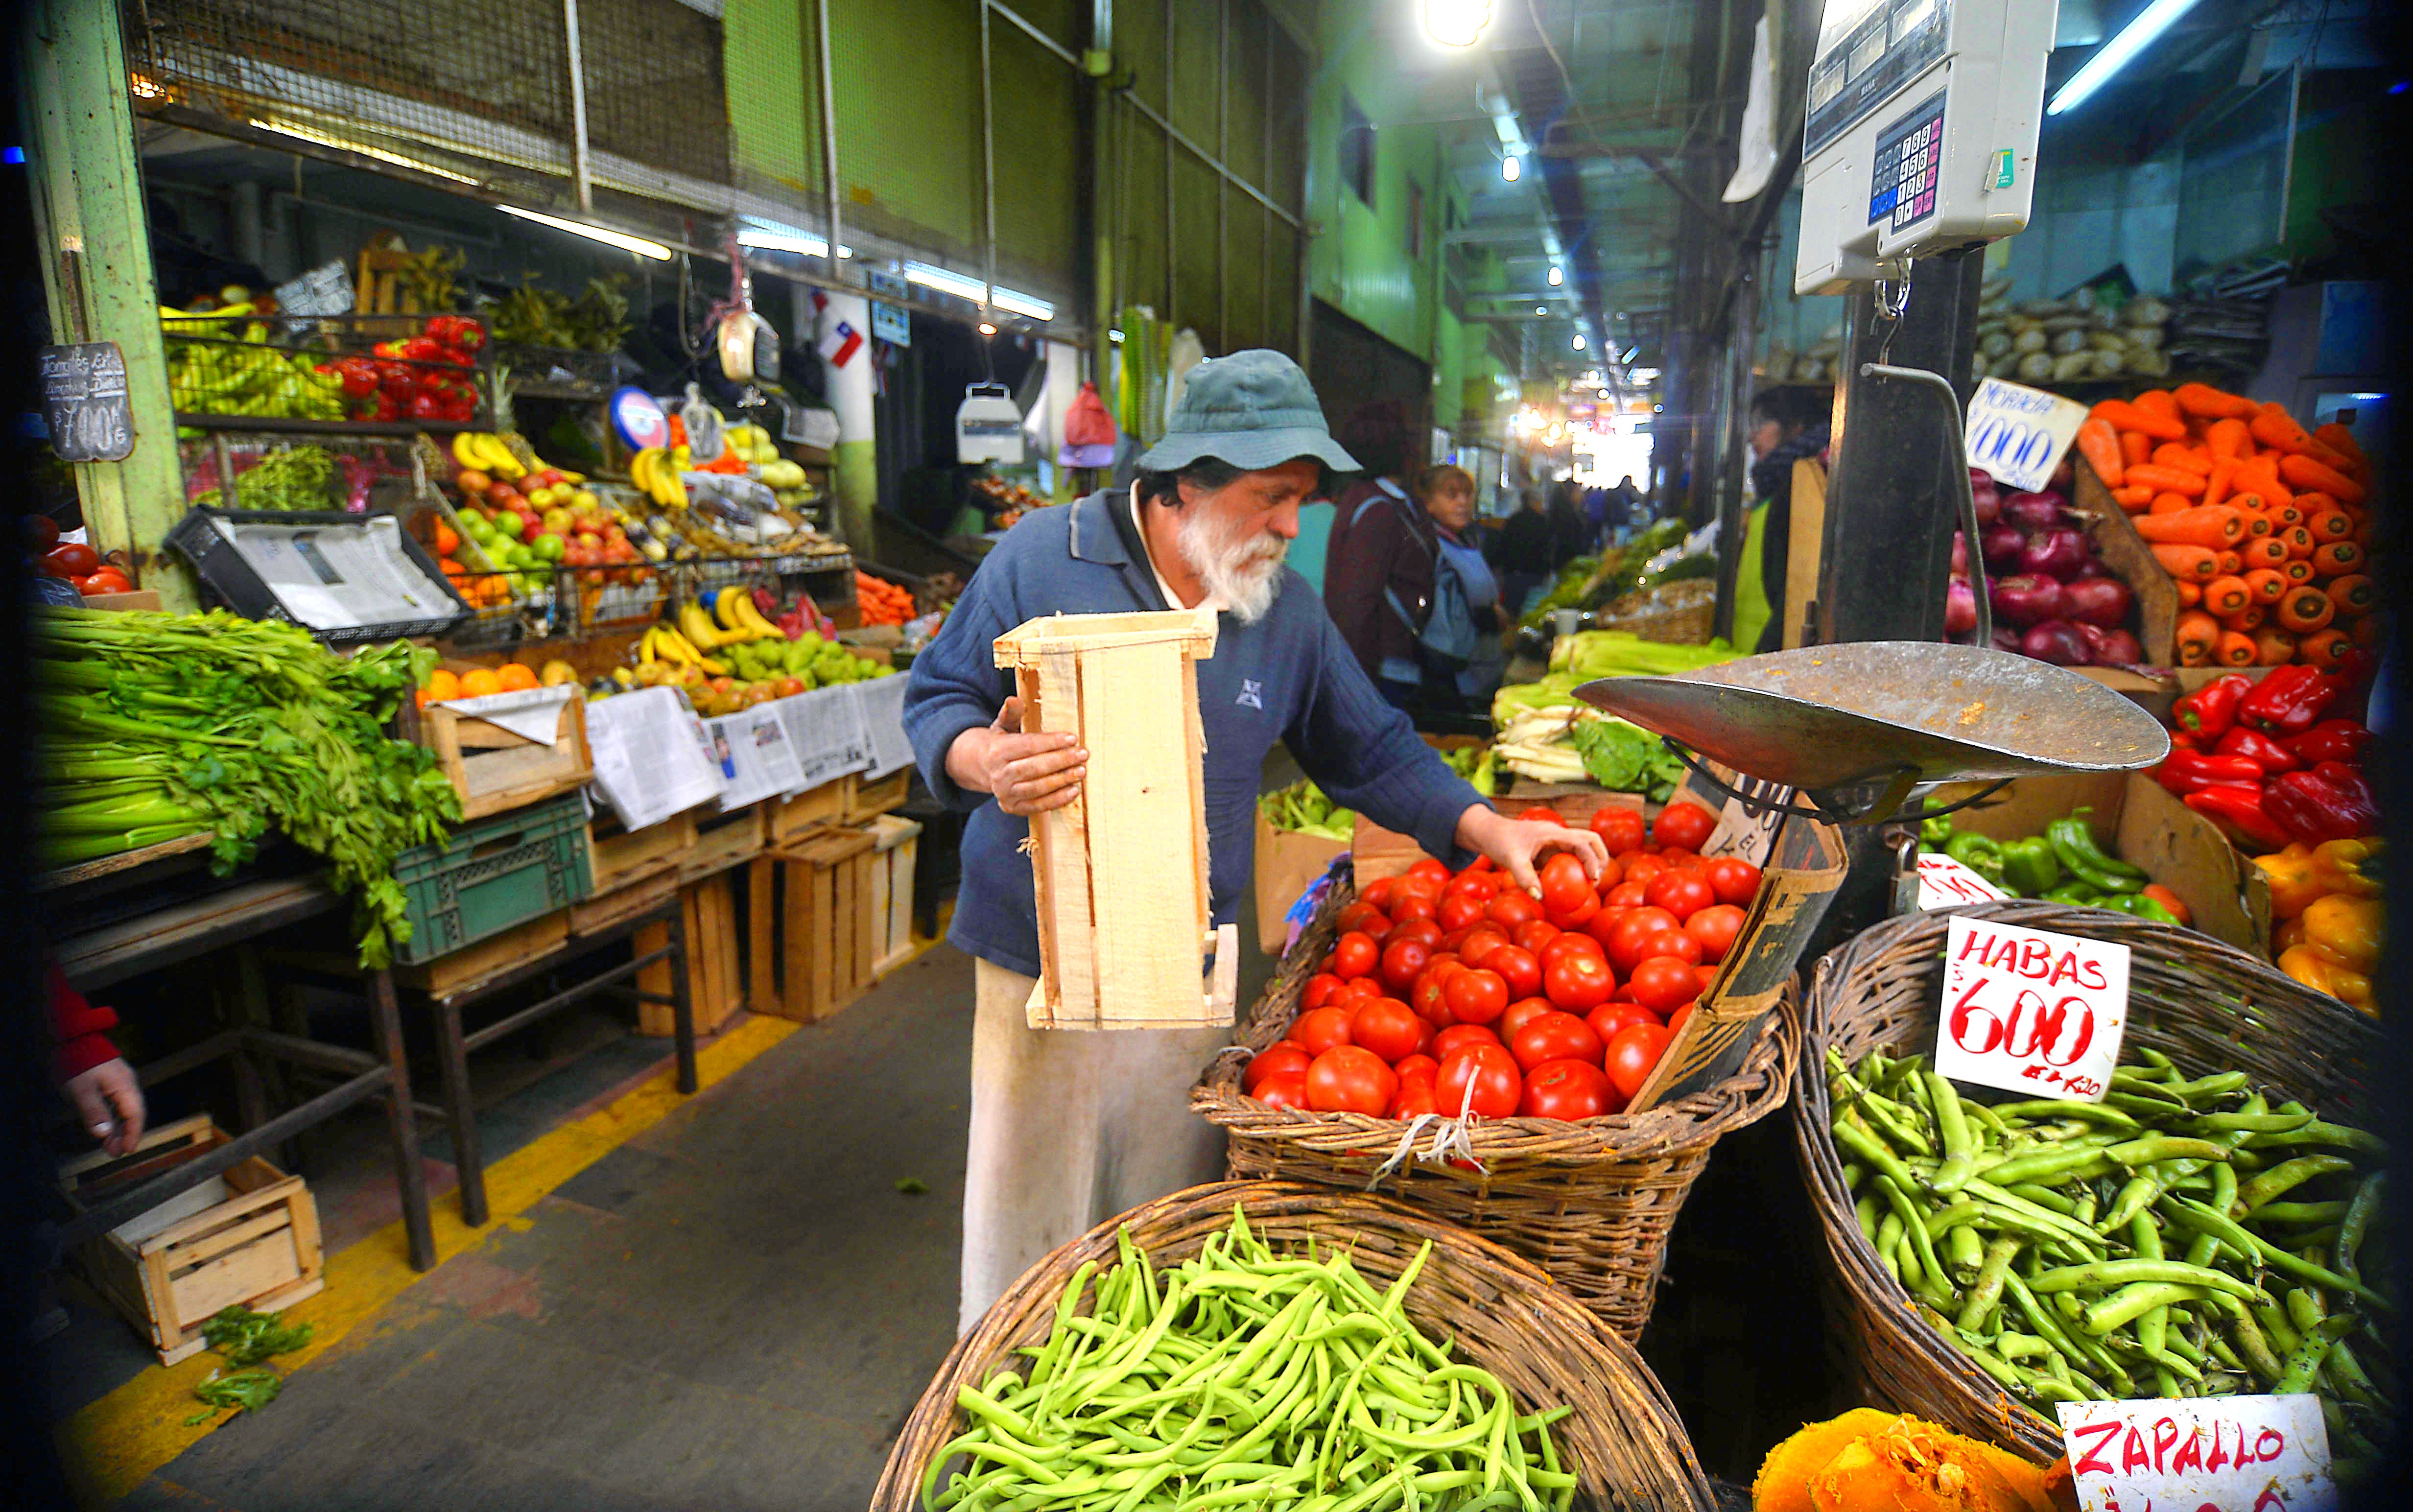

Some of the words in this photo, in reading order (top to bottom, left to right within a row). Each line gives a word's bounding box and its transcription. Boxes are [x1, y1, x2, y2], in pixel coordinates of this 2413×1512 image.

[1913, 135, 1918, 149] 8
[1923, 128, 1928, 144] 9
[1910, 158, 1915, 173] 5
[1919, 151, 1925, 166] 6
[1908, 180, 1913, 195] 2
[2074, 1417, 2284, 1477] ZAPALLO
